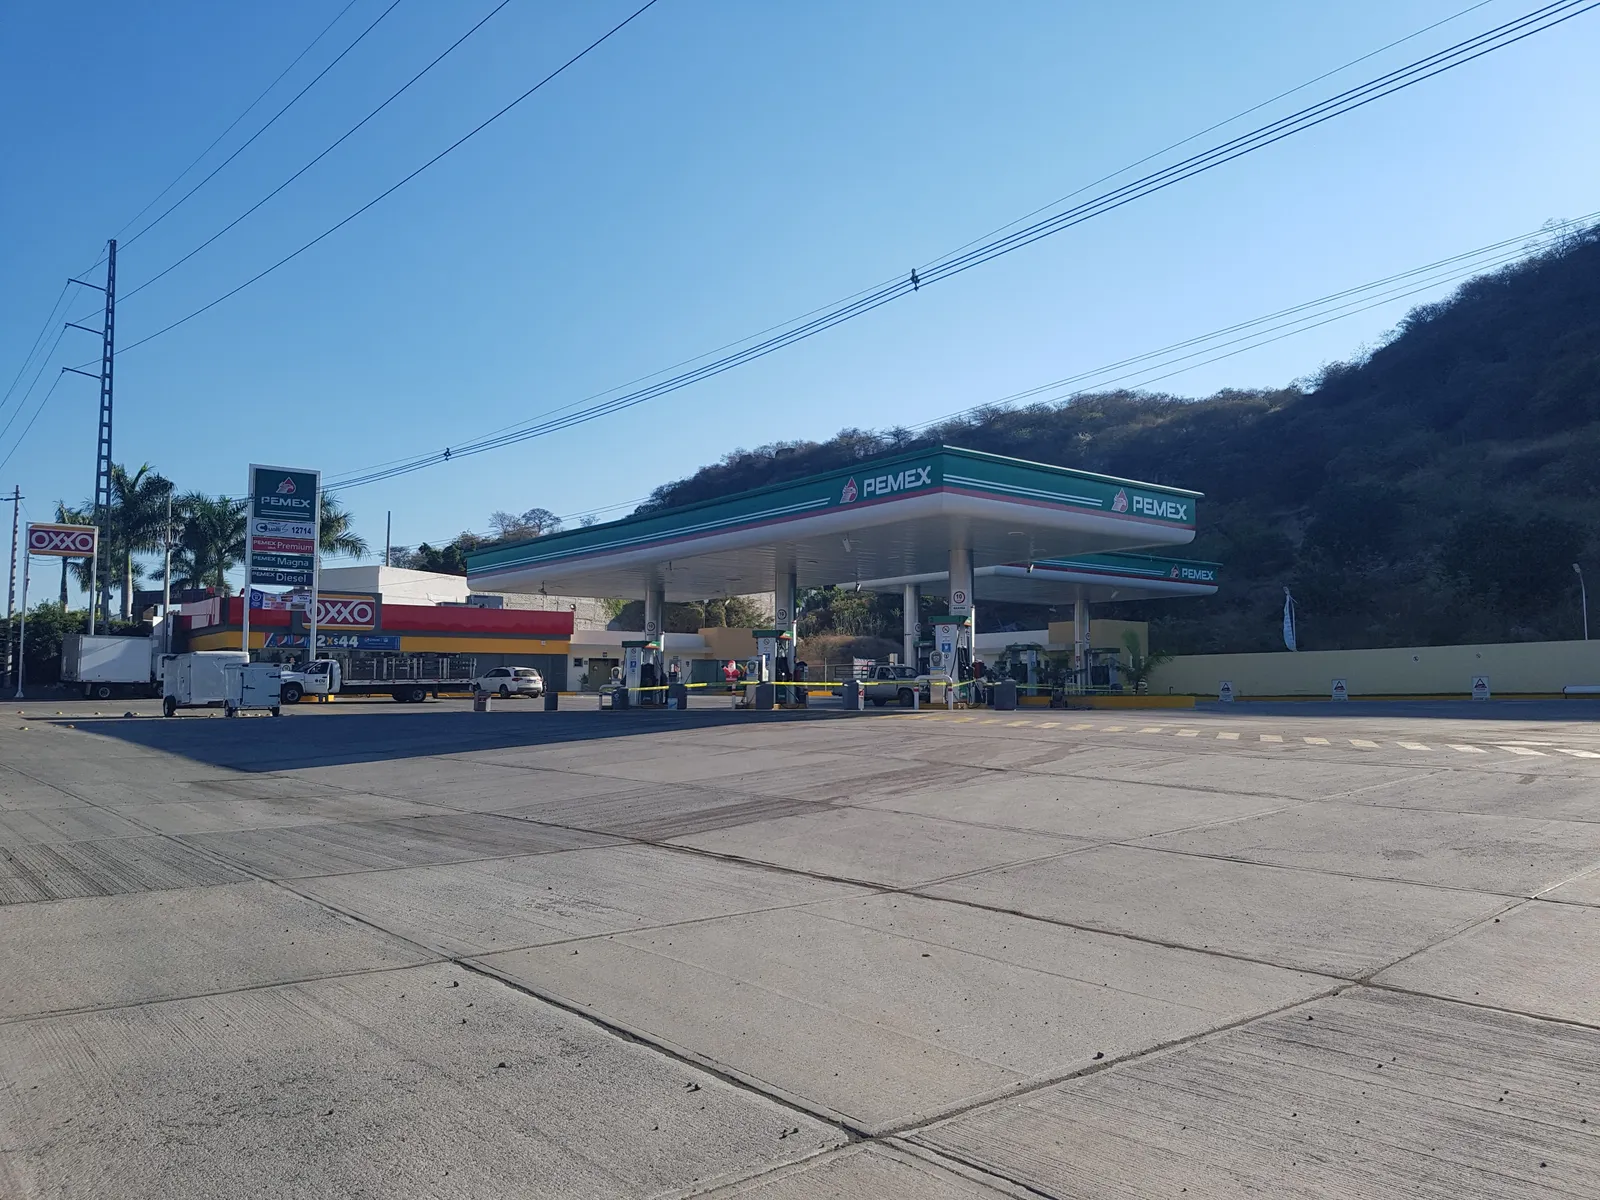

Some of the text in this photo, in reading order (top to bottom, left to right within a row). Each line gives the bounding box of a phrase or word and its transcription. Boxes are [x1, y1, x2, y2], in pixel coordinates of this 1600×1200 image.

[863, 465, 931, 498] PEMEX
[261, 496, 311, 508] PEMEX
[1132, 495, 1188, 521] PEMEX
[291, 526, 312, 535] 12714
[31, 531, 93, 551] OXXO
[277, 541, 313, 551] Premium
[277, 557, 309, 568] Magna
[276, 572, 307, 583] Diesel
[1181, 568, 1214, 581] PEMEX
[306, 601, 373, 623] OXXO
